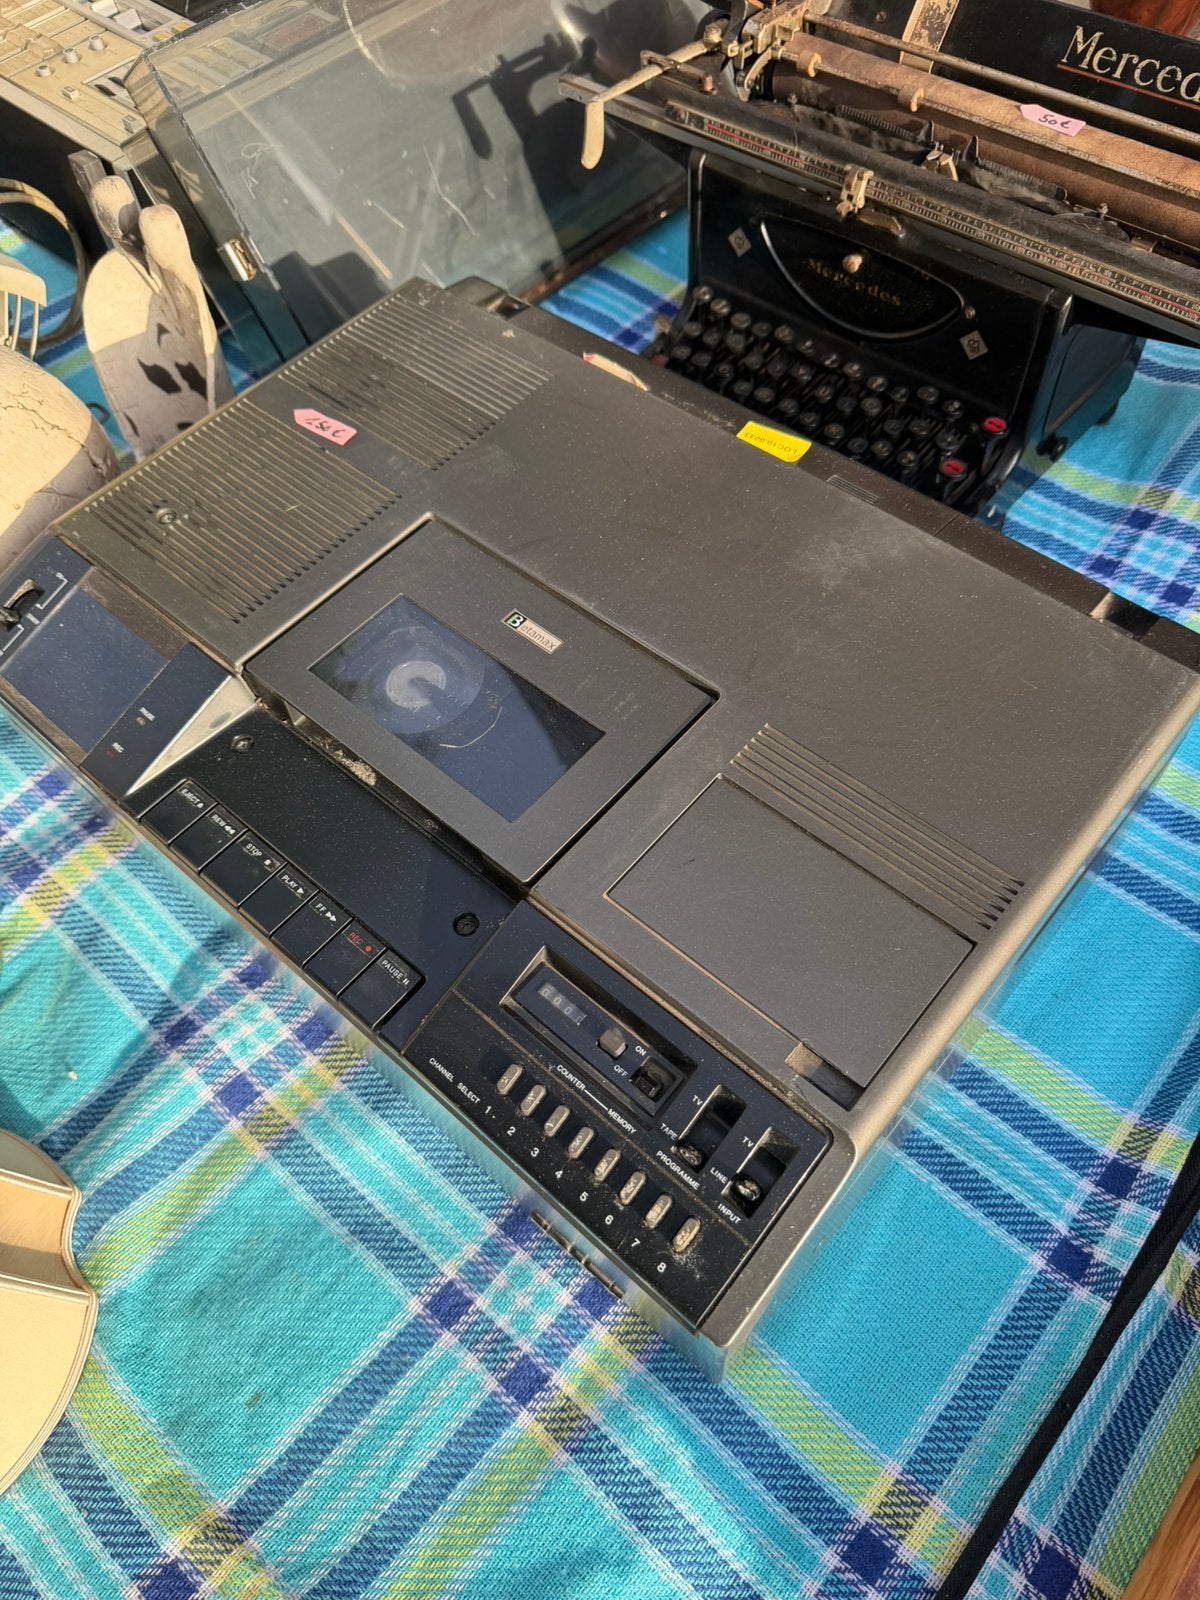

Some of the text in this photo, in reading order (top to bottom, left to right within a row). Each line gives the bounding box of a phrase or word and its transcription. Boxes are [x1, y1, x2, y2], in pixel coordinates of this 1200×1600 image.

[504, 613, 556, 650] Betamax
[180, 788, 200, 804] EJECT
[211, 814, 227, 827] REW
[245, 843, 263, 857] STOP
[281, 874, 298, 889] PLAY
[315, 902, 327, 912] FF
[349, 932, 364, 945] REC
[381, 959, 404, 979] PAUSE
[635, 1045, 647, 1057] ON
[613, 1064, 629, 1078] OFF
[428, 1057, 481, 1104] CHANNEL SELECT
[556, 1064, 637, 1135] COUNTER MEMORY
[692, 1094, 703, 1106] TV
[506, 1126, 516, 1136] 2
[660, 1122, 678, 1141] TAPE
[742, 1135, 754, 1148] TV
[530, 1147, 540, 1157] 3
[555, 1170, 563, 1179] 4
[656, 1150, 700, 1191] PROGRAMME
[710, 1166, 728, 1185] LINE
[579, 1191, 589, 1202] 5
[604, 1214, 614, 1225] 6
[717, 1202, 741, 1225] INPUT
[631, 1237, 641, 1248] 7
[657, 1262, 667, 1273] 8
